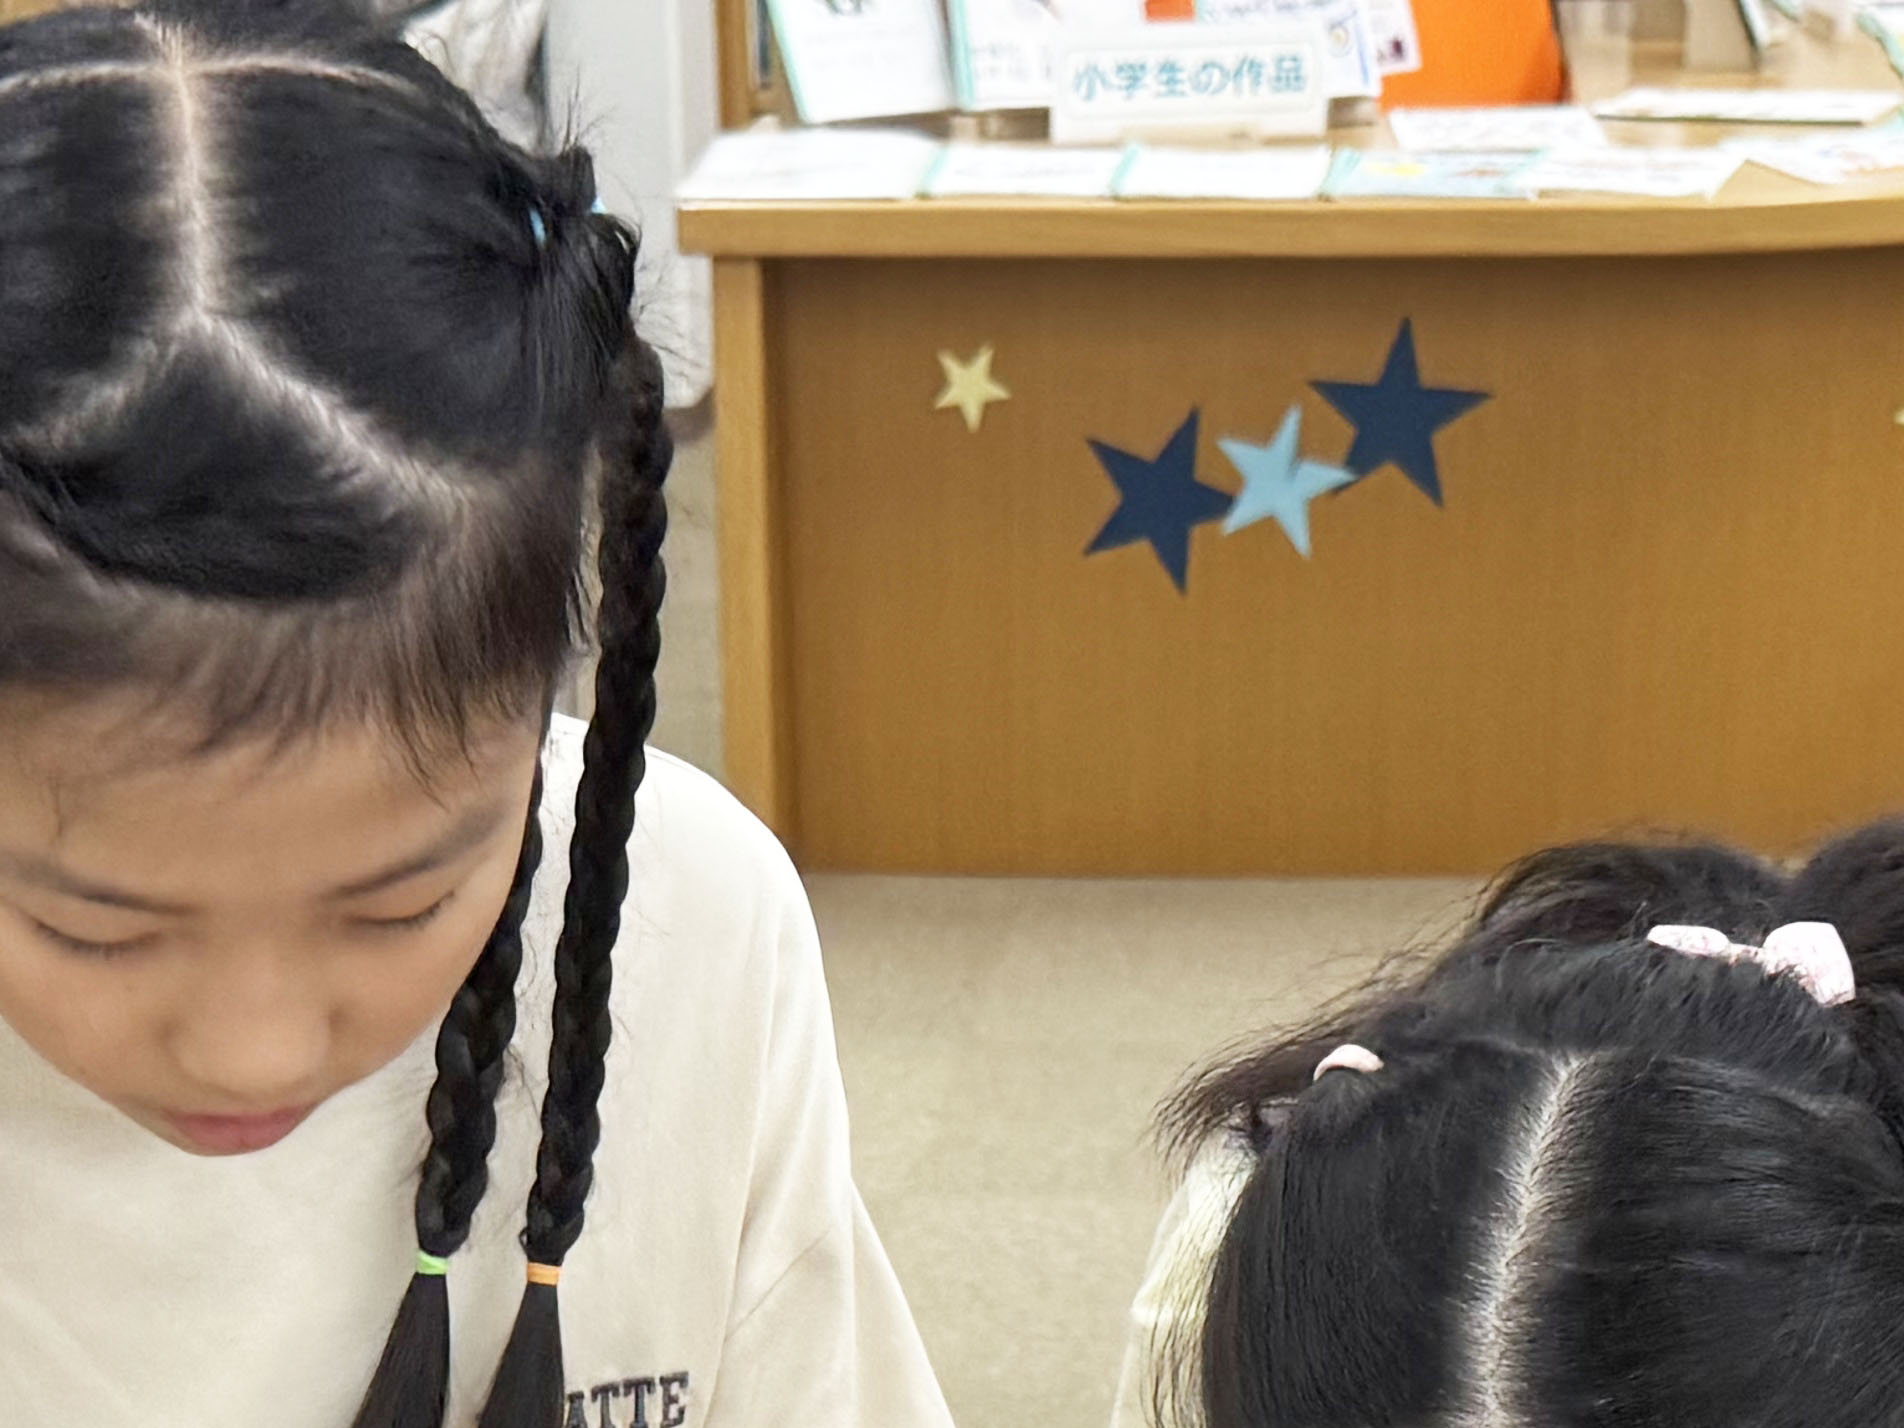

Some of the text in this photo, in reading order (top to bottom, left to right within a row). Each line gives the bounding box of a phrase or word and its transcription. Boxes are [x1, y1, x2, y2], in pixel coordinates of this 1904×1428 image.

[1073, 54, 1307, 100] 小学生の作品
